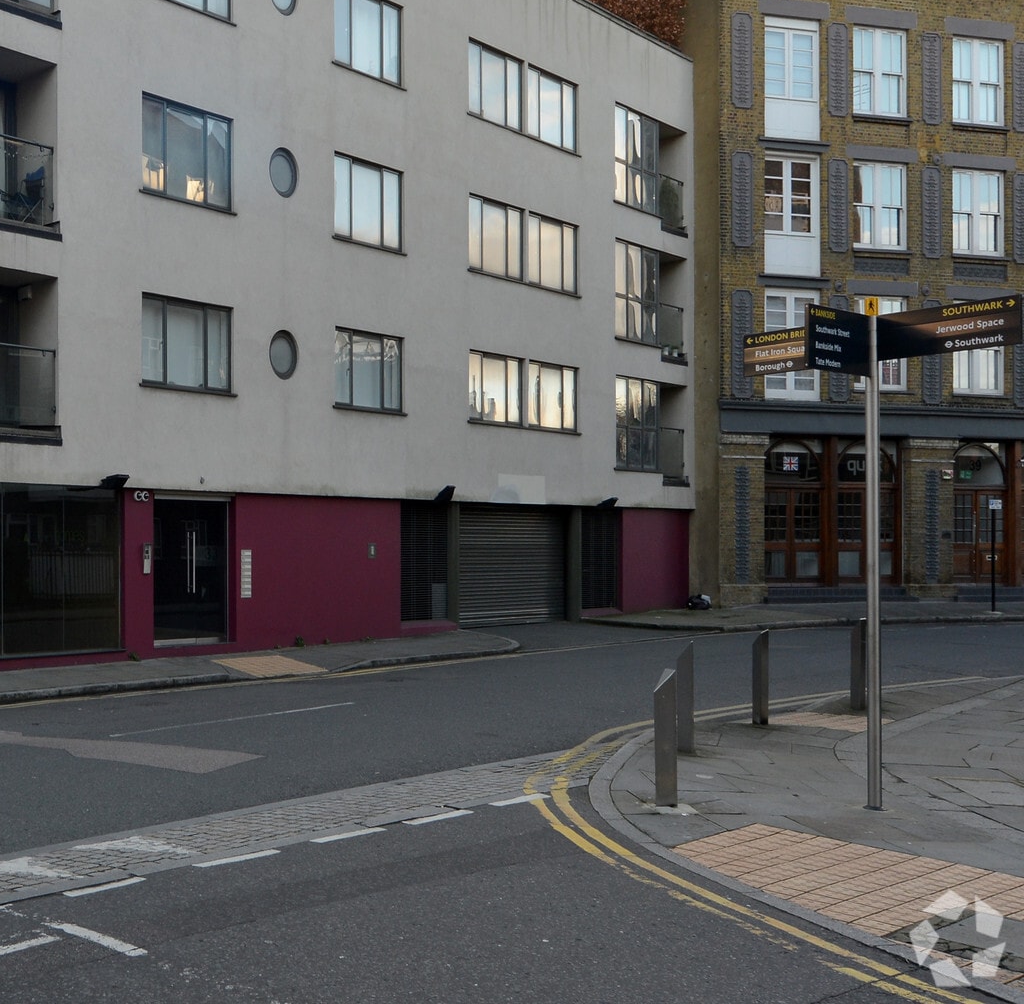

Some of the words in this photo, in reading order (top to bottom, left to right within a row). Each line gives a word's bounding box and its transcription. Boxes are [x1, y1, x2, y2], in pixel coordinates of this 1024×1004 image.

[815, 308, 836, 320] BANKSIDE
[942, 300, 1004, 317] SOUTHWARK
[815, 324, 837, 337] Southwark
[837, 328, 851, 338] Street
[936, 321, 975, 334] Jerwood
[976, 318, 1005, 330] Space
[755, 332, 789, 344] LONDON
[954, 334, 1004, 347] Southwark
[815, 340, 834, 352] Bankside
[755, 350, 770, 358] Flat
[770, 348, 786, 357] Iron
[755, 361, 786, 372] Borough
[815, 356, 825, 366] Tate
[825, 358, 842, 369] Modern
[969, 459, 982, 471] 39
